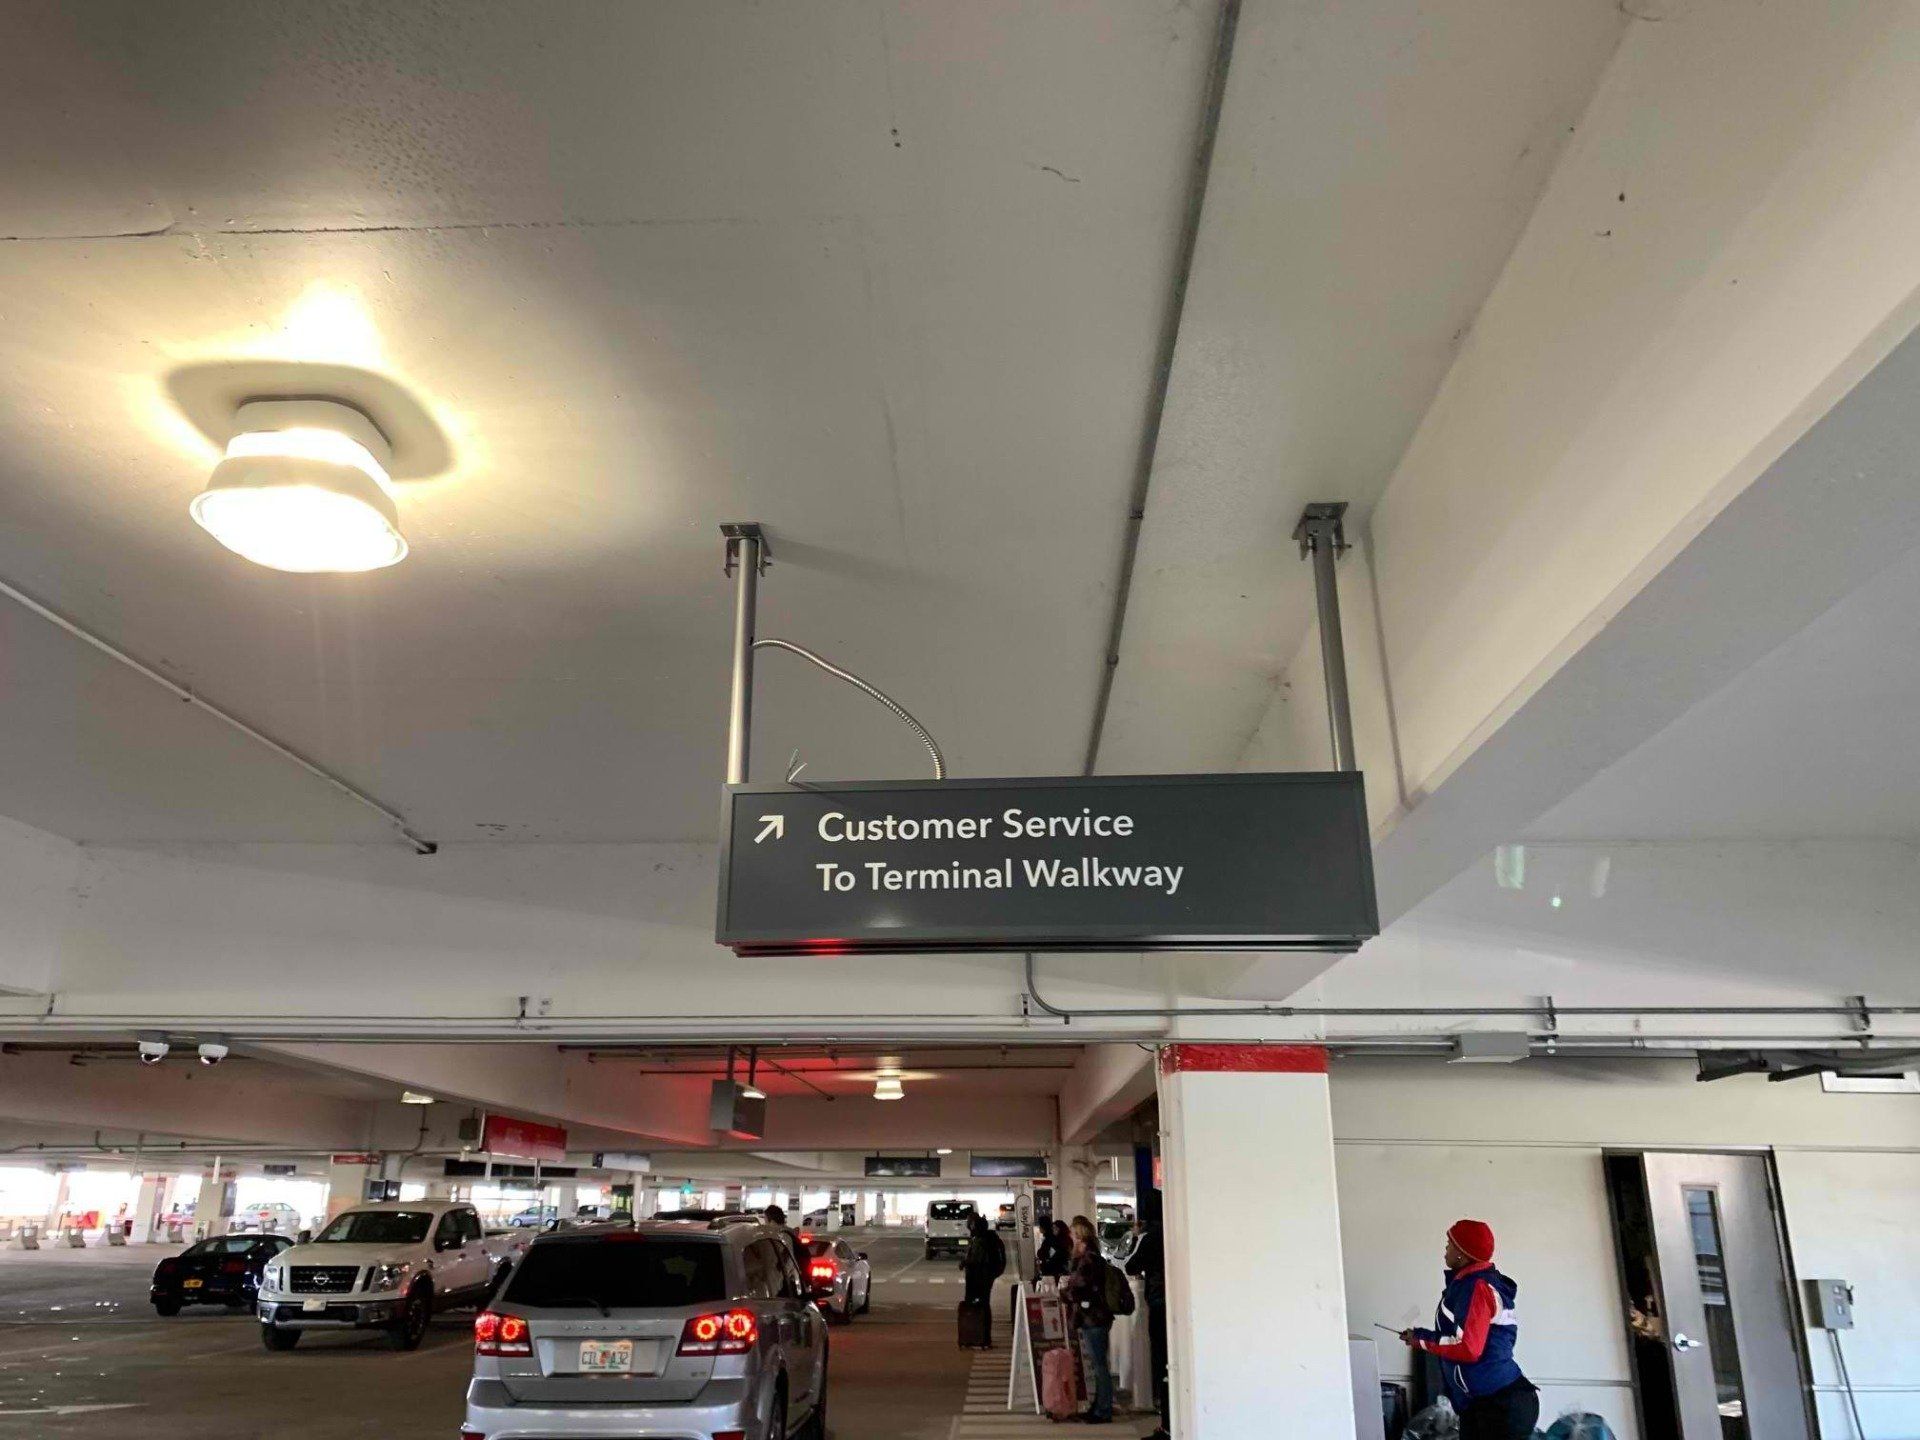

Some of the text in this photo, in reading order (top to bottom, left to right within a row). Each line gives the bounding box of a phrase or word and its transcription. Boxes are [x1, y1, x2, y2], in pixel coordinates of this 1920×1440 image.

[817, 807, 1134, 842] Customer Service
[815, 856, 1184, 895] To Terminal Walkway
